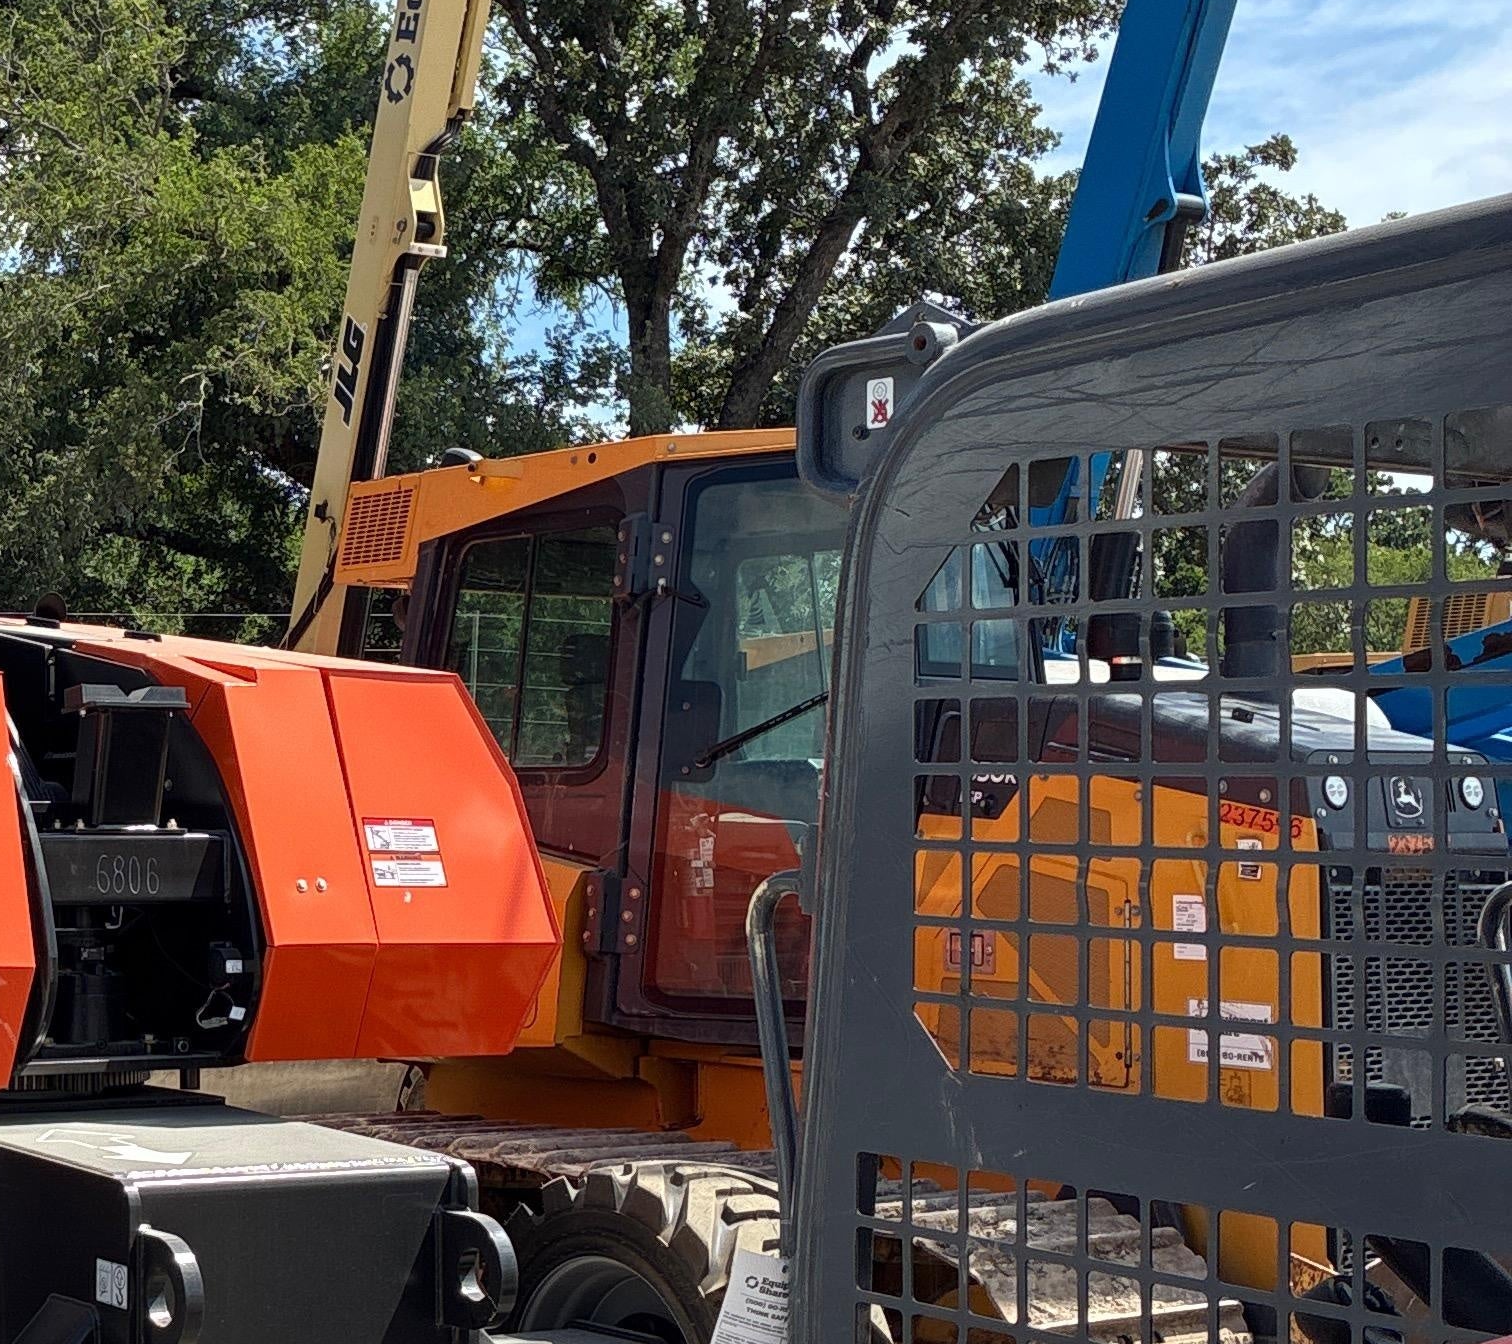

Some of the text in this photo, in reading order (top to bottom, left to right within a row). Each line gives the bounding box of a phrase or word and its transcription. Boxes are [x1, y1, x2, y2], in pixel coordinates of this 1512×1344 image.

[331, 314, 367, 430] JLG
[1220, 802, 1303, 839] 23756
[96, 854, 160, 895] 6806
[761, 1276, 789, 1291] Equip
